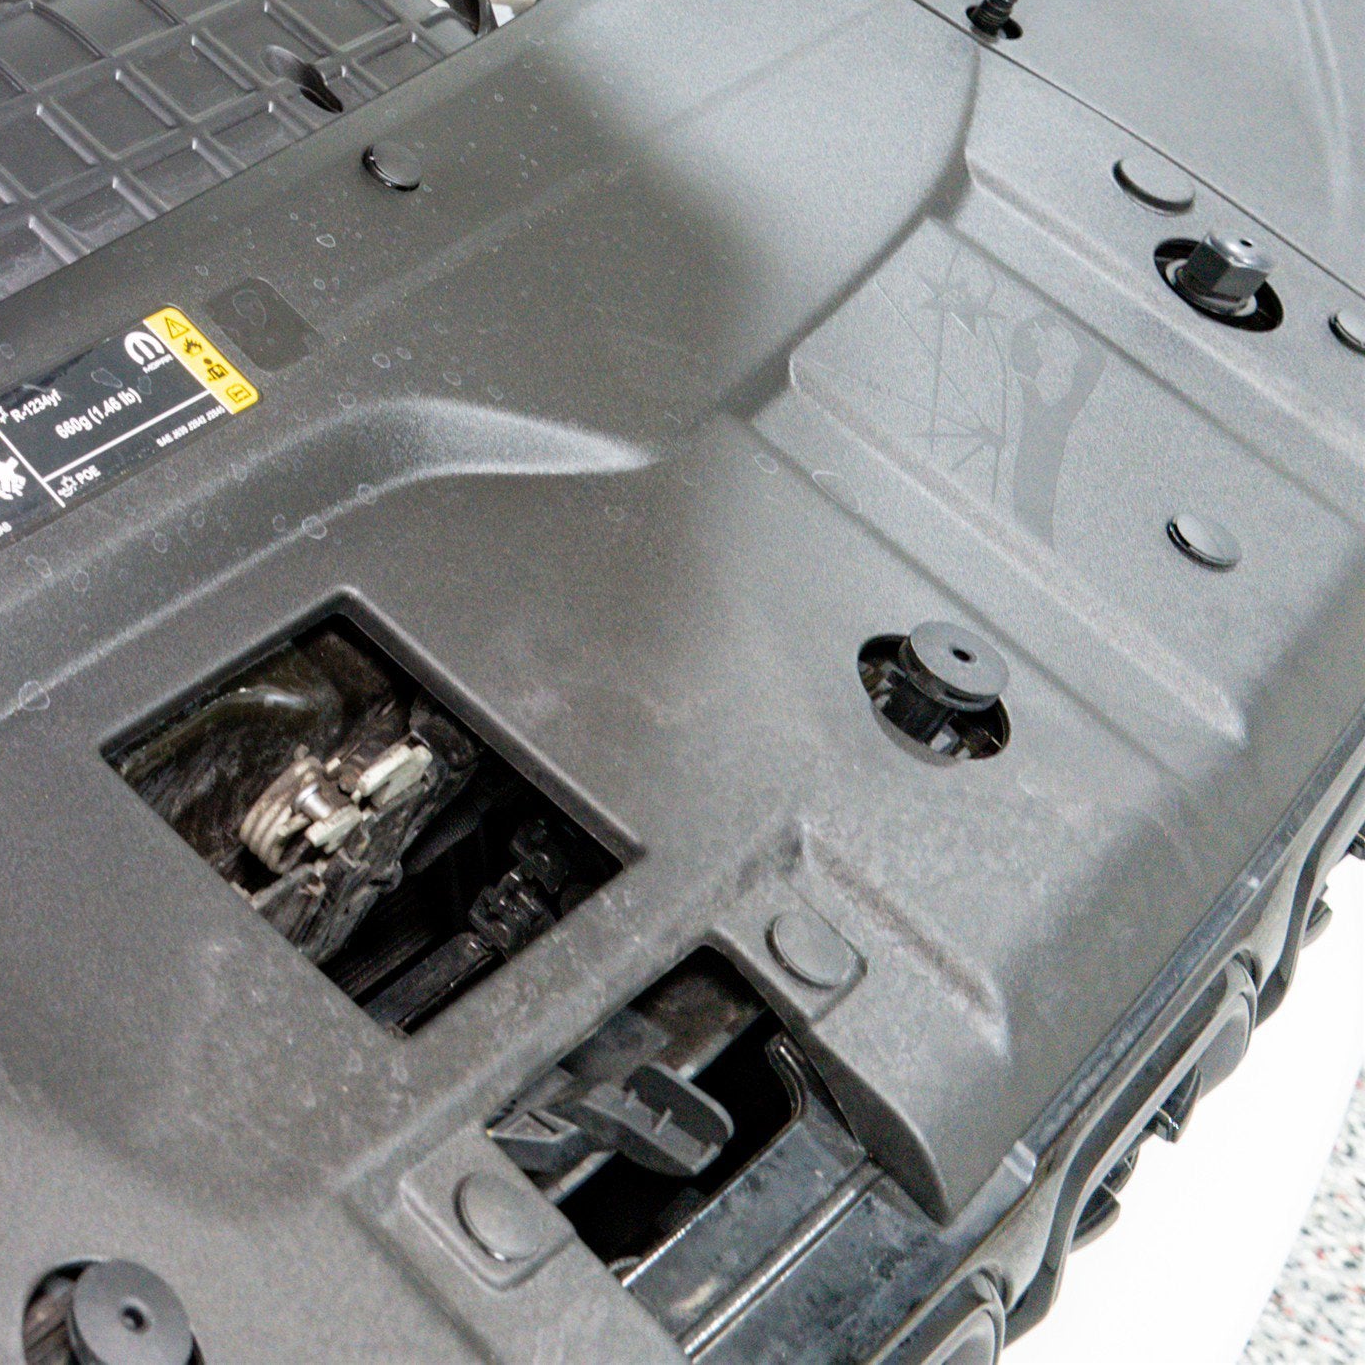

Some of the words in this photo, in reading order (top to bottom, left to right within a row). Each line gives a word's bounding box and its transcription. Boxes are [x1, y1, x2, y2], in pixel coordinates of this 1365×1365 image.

[9, 388, 62, 423] R-1234yf
[55, 414, 93, 439] 660g
[87, 396, 122, 425] (1.46
[117, 387, 142, 406] lb)
[74, 464, 101, 485] POE
